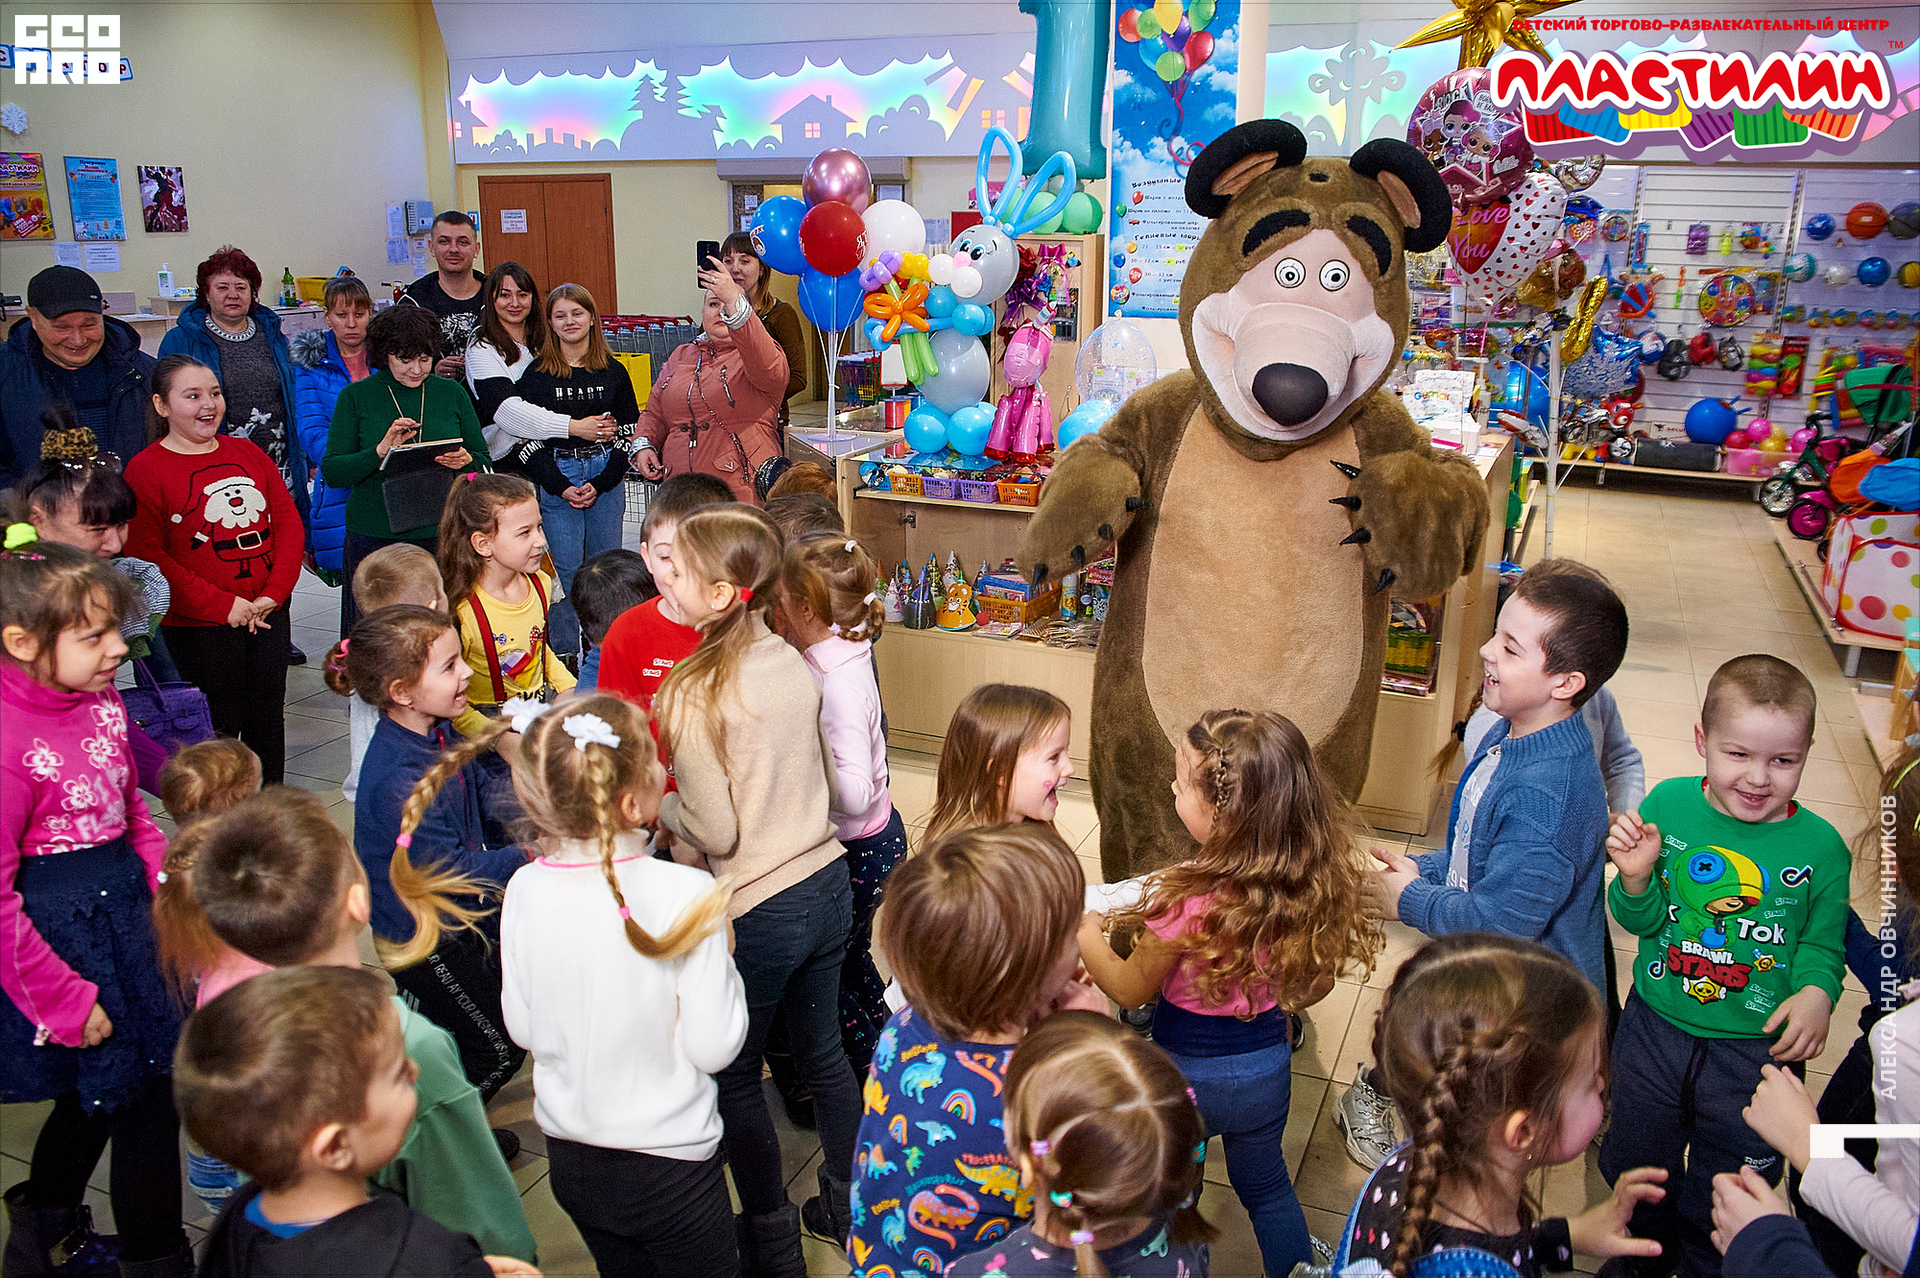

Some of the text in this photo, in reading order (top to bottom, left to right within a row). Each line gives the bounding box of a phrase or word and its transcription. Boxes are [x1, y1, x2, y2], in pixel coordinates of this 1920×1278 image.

[1457, 206, 1511, 227] Love
[1452, 234, 1492, 259] You
[555, 386, 604, 400] HEART
[1681, 940, 1736, 965] BRAWL
[1668, 944, 1753, 988] STARS
